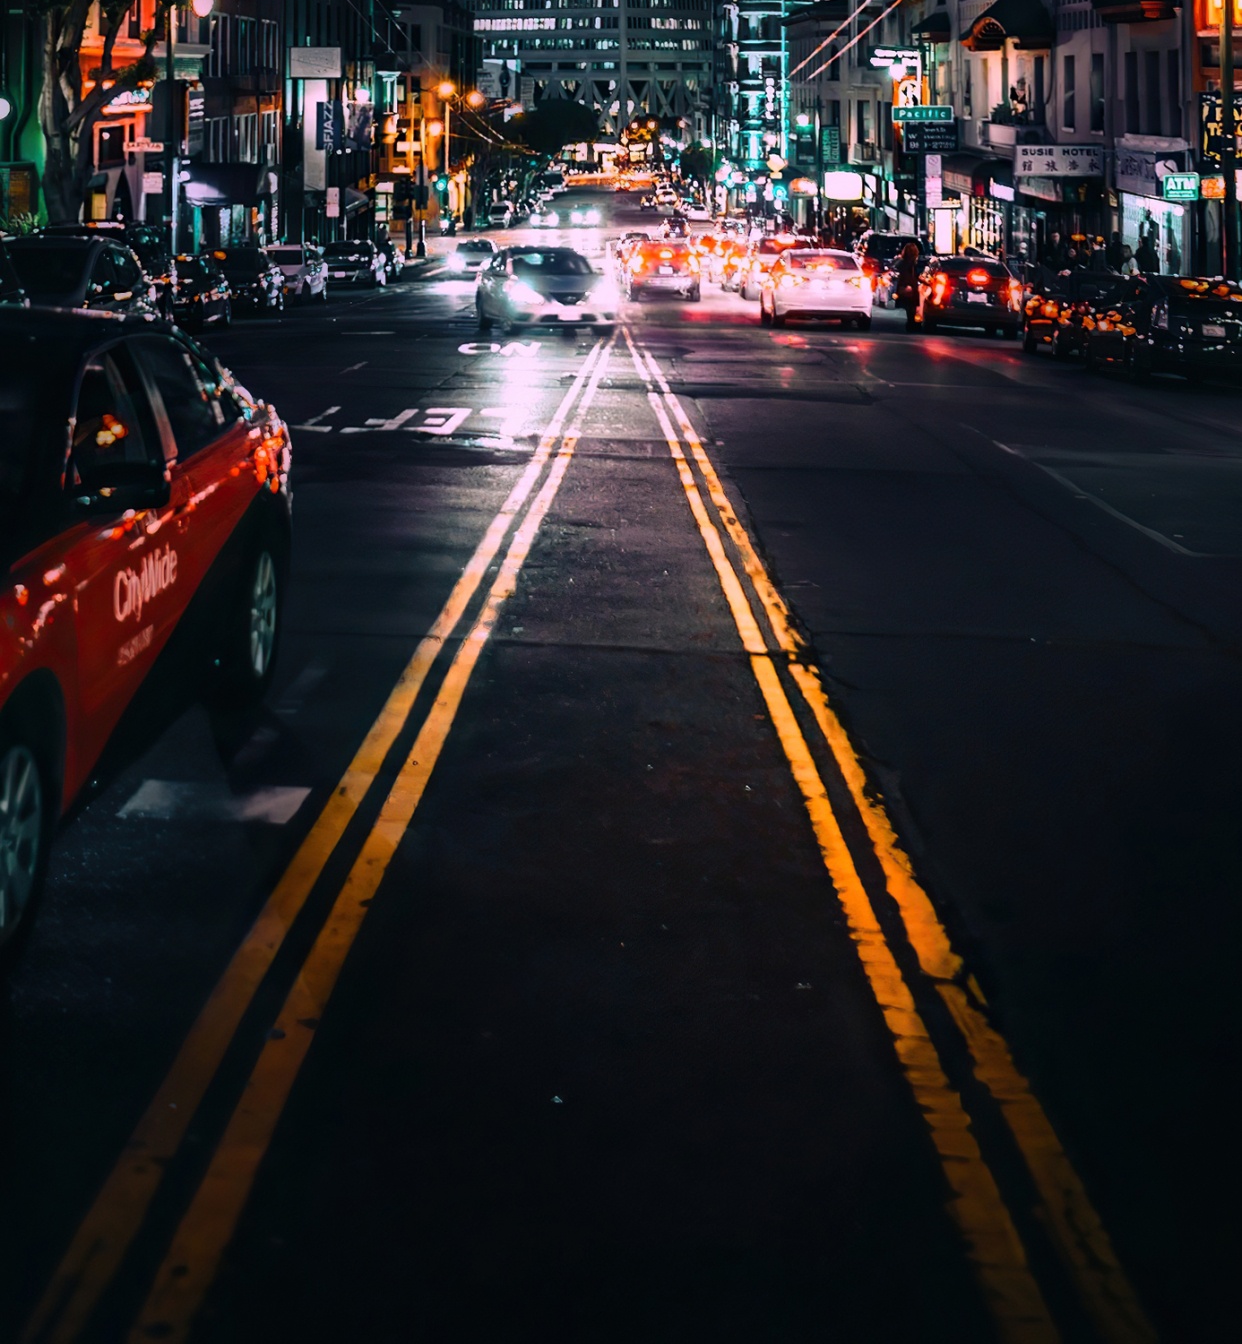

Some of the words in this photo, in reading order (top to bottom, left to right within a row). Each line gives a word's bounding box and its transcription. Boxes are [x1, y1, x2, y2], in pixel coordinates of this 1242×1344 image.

[899, 109, 946, 118] Pacific
[323, 100, 334, 153] SFJAZZ
[1021, 148, 1054, 156] SUSIE
[1062, 148, 1099, 156] HOTEL
[1166, 177, 1196, 190] ATM
